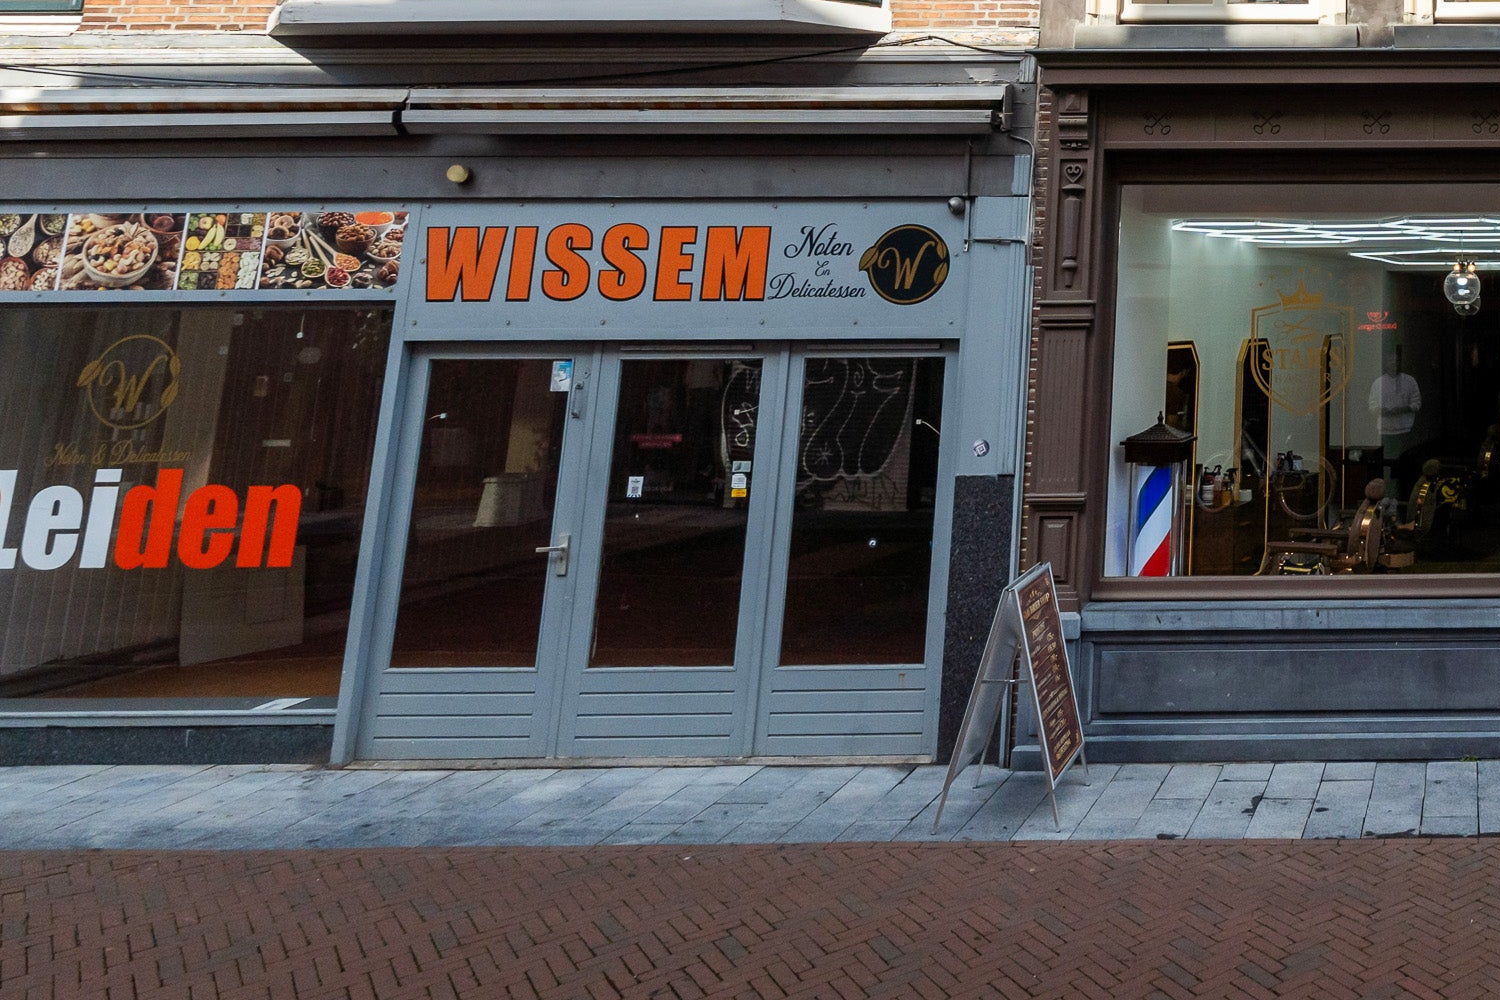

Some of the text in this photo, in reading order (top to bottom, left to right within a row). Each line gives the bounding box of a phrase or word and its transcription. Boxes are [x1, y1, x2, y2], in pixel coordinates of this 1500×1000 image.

[783, 222, 855, 258] Noten
[425, 222, 773, 303] WISSEM
[814, 260, 832, 278] En
[767, 271, 868, 300] Delicatessen
